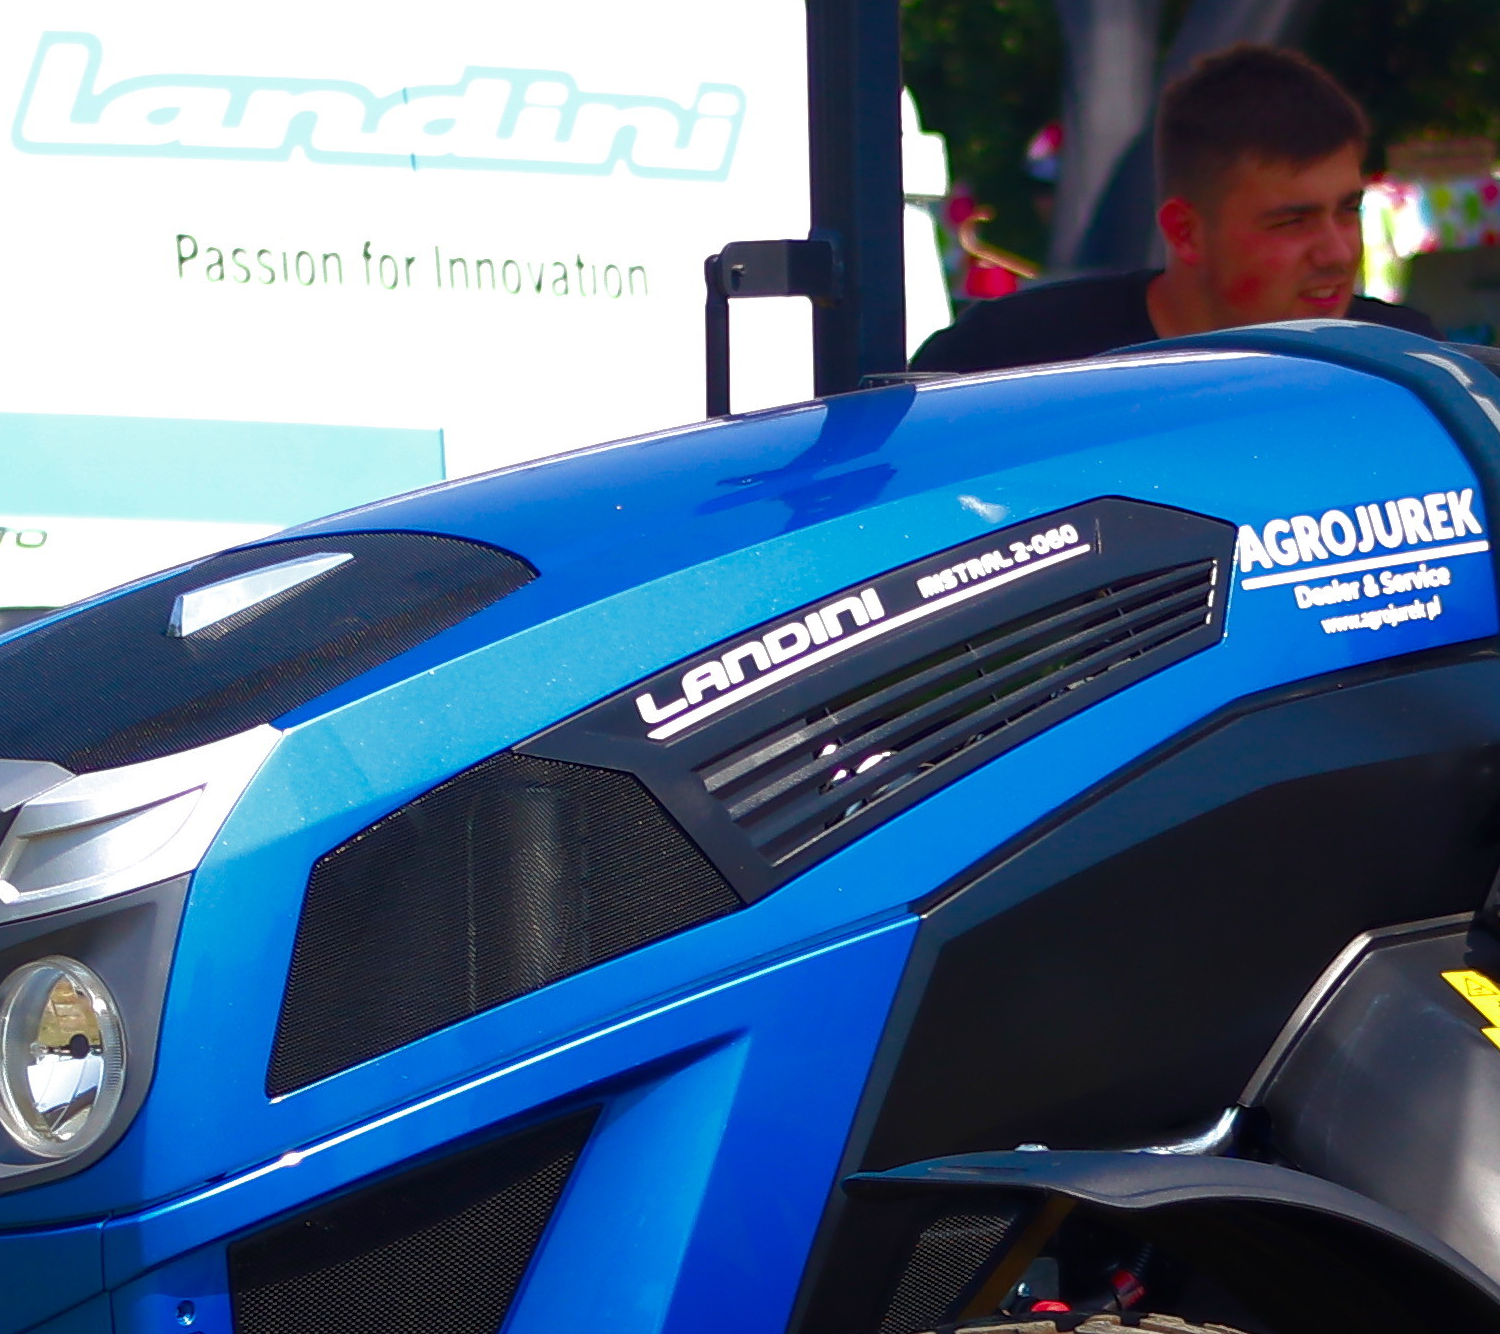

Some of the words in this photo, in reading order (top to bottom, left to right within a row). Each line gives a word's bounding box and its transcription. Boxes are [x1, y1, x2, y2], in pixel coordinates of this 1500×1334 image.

[12, 30, 748, 183] Landini
[174, 232, 345, 290] Passion
[363, 239, 417, 290] for
[1238, 487, 1483, 573] AGROJUREK
[1293, 579, 1360, 609] Dealer
[1362, 574, 1381, 598] &
[1379, 563, 1451, 595] Service
[634, 587, 887, 725] LANDINI
